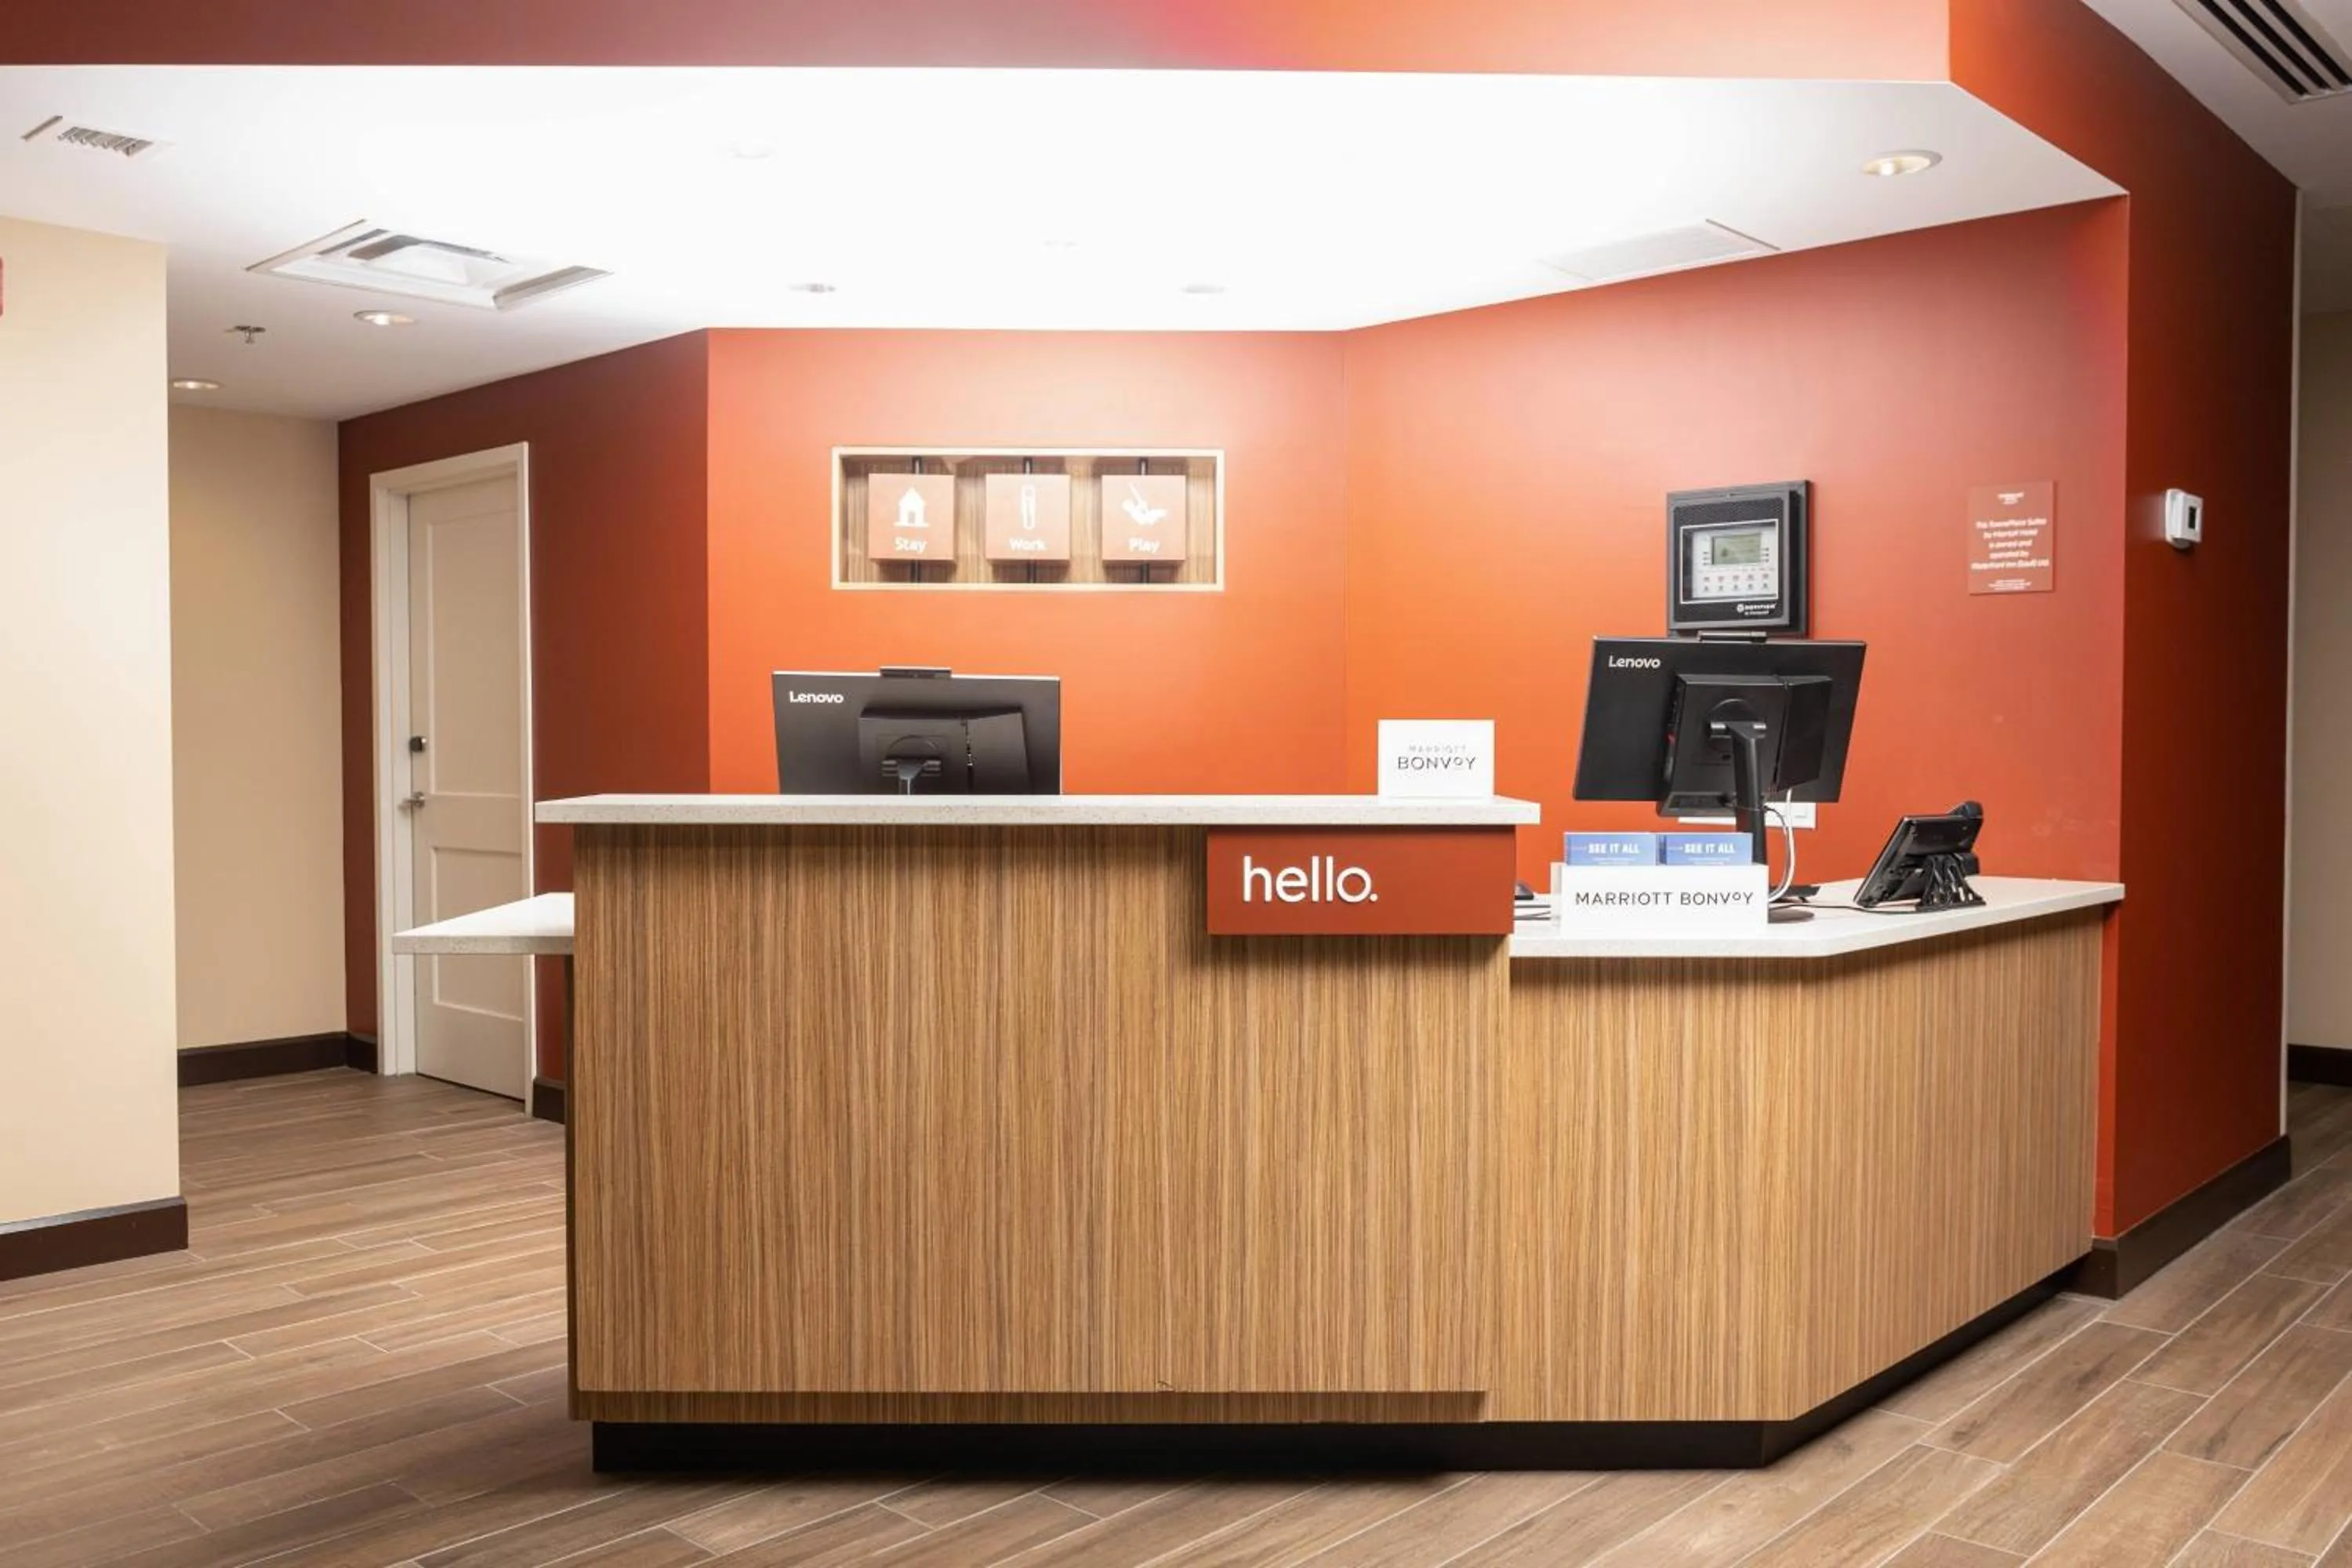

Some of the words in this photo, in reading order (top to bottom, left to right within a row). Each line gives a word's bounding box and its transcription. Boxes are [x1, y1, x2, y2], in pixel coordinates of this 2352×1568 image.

[895, 537, 927, 552] Stay
[1009, 537, 1046, 551] Work
[1128, 537, 1160, 554] Play
[1608, 655, 1661, 669] Lenovo
[789, 690, 844, 704] Lenovo
[1588, 843, 1606, 855] SEE
[1610, 843, 1619, 855] IT
[1622, 843, 1640, 855] ALL
[1684, 843, 1703, 855] SEE
[1705, 843, 1715, 855] IT
[1718, 843, 1735, 855] ALL
[1243, 855, 1378, 902] hello.
[1575, 891, 1672, 906] MARRIOTT
